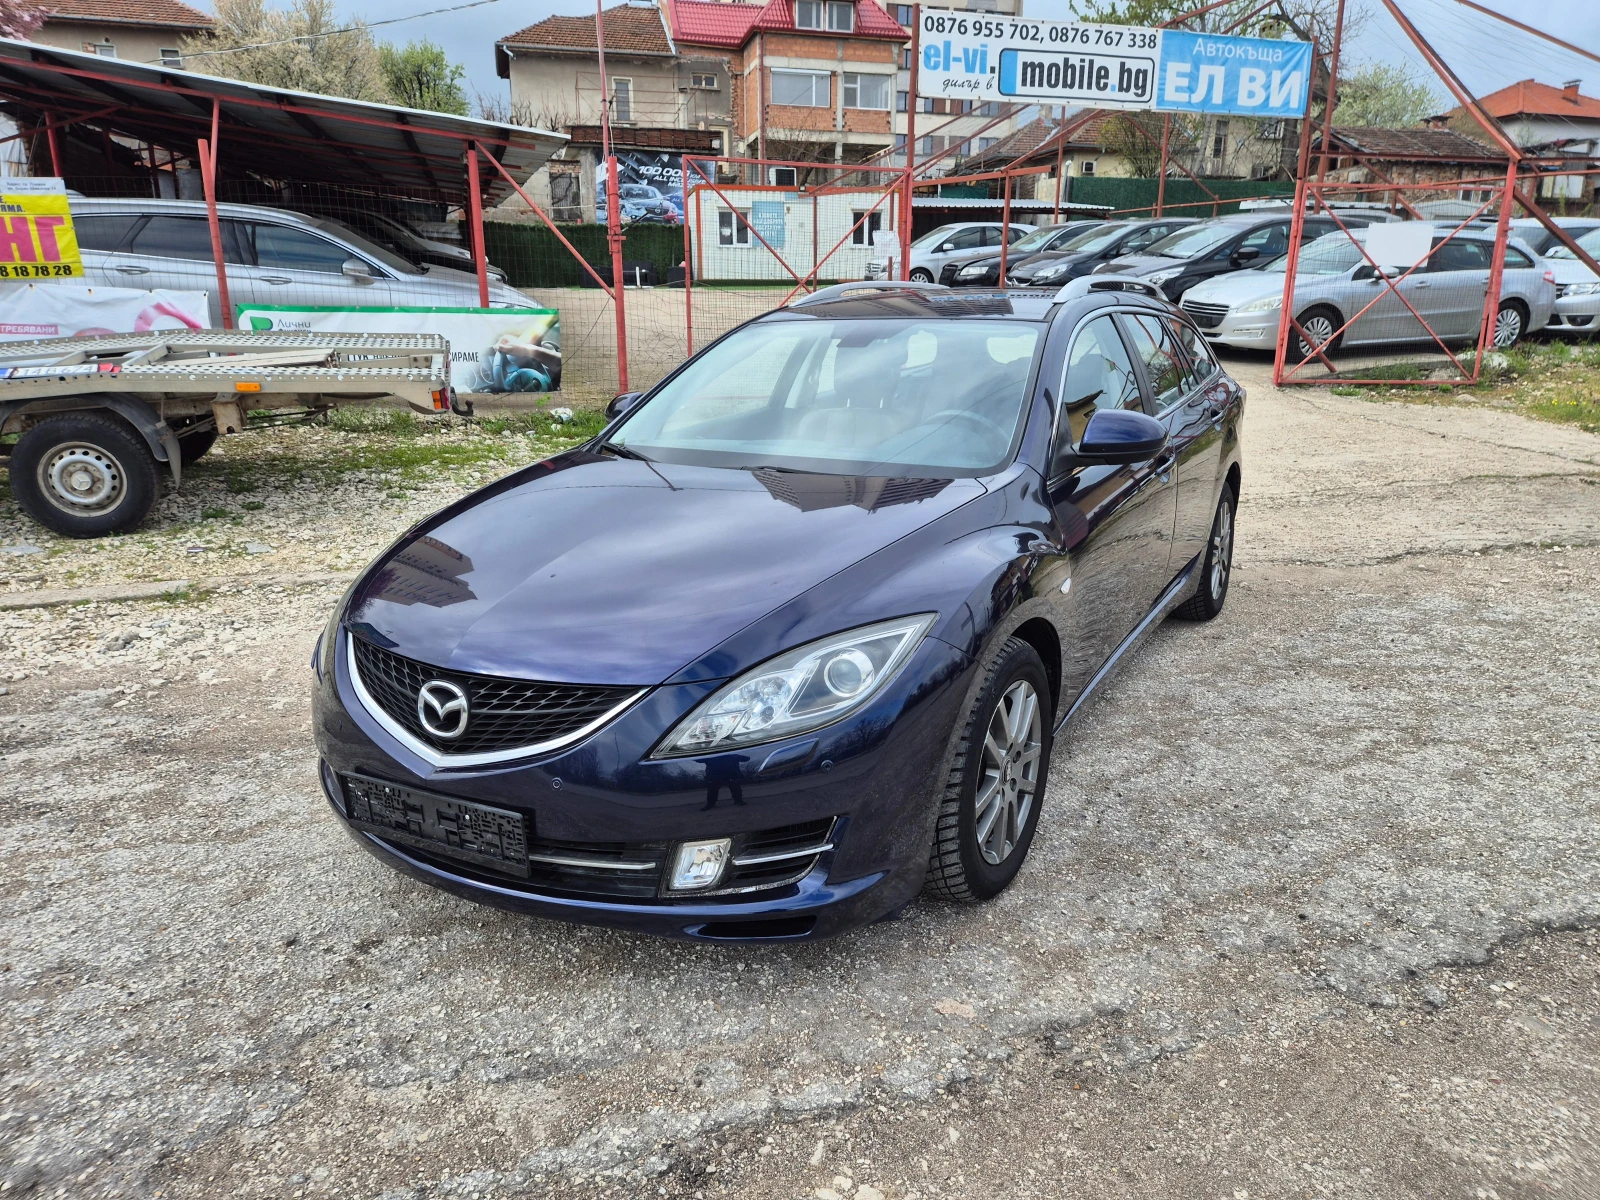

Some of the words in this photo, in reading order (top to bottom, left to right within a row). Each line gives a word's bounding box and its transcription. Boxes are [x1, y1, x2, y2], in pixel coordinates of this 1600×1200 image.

[924, 15, 968, 36] 0876
[972, 20, 1004, 39] 955
[1009, 23, 1045, 44] 702,
[1049, 26, 1090, 44] 0876
[1094, 29, 1124, 47] 767
[1128, 33, 1157, 49] 338
[1192, 37, 1283, 65] Автокъща
[923, 40, 996, 75] el-vi.
[1021, 57, 1148, 98] mobile.bg
[942, 78, 980, 92] дилър
[1164, 61, 1226, 105] ЕЛ
[1237, 67, 1303, 110] ВИ
[639, 165, 662, 175] 100
[11, 265, 30, 277] 18
[31, 265, 51, 277] 78
[52, 264, 73, 276] 28
[277, 318, 312, 329] Лични
